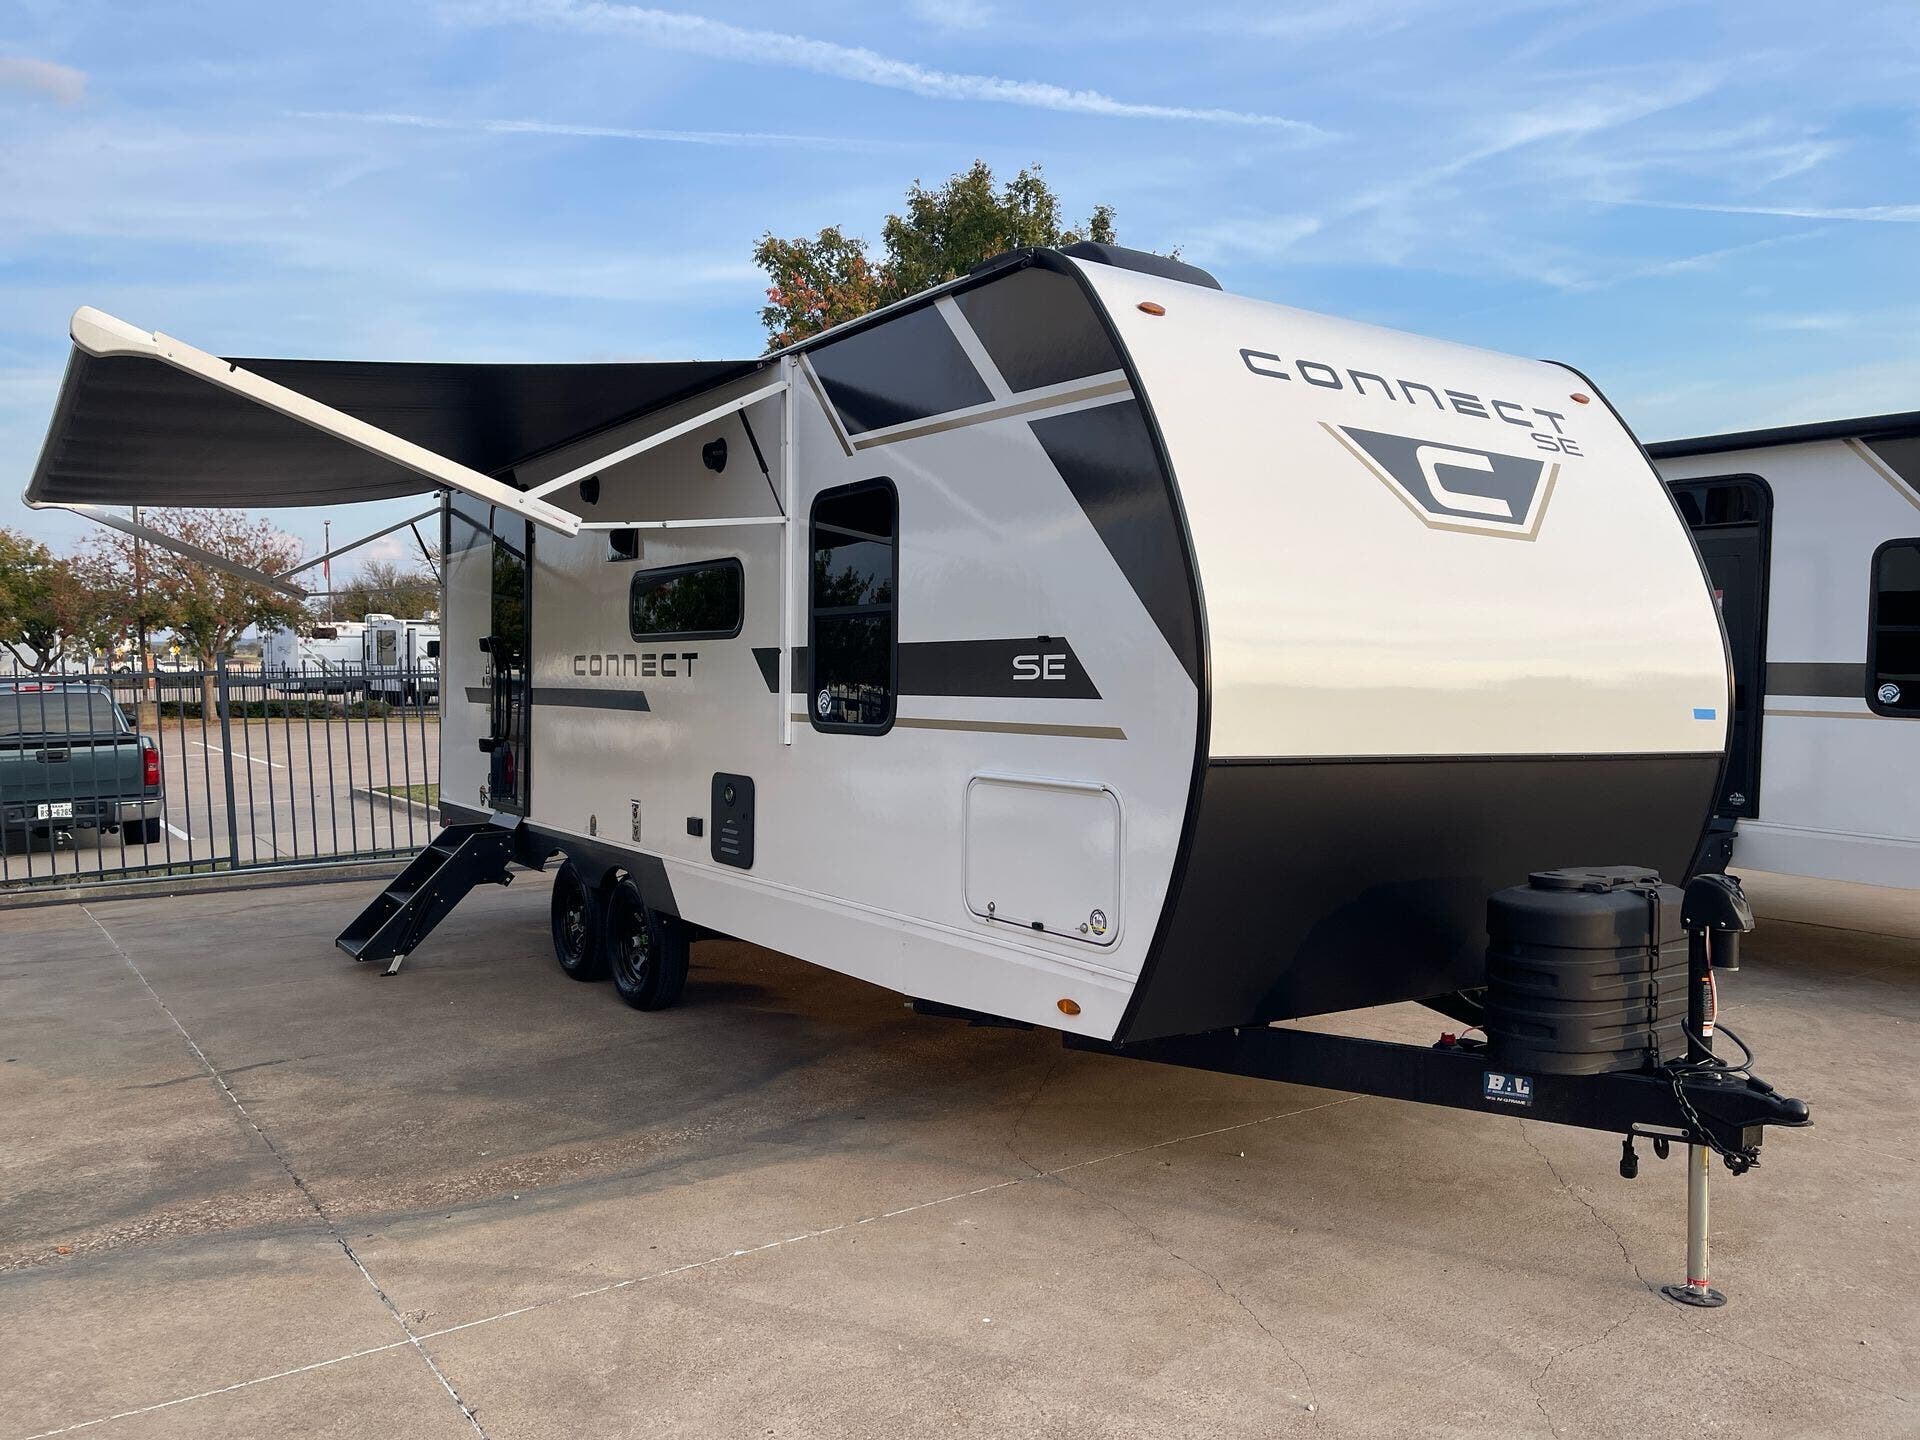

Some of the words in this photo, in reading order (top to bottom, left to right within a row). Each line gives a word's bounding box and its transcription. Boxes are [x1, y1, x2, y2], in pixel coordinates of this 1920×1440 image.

[1239, 348, 1565, 434] CONNECT
[1530, 432, 1584, 457] SE
[574, 652, 698, 677] CONNECT
[1013, 654, 1066, 680] SE
